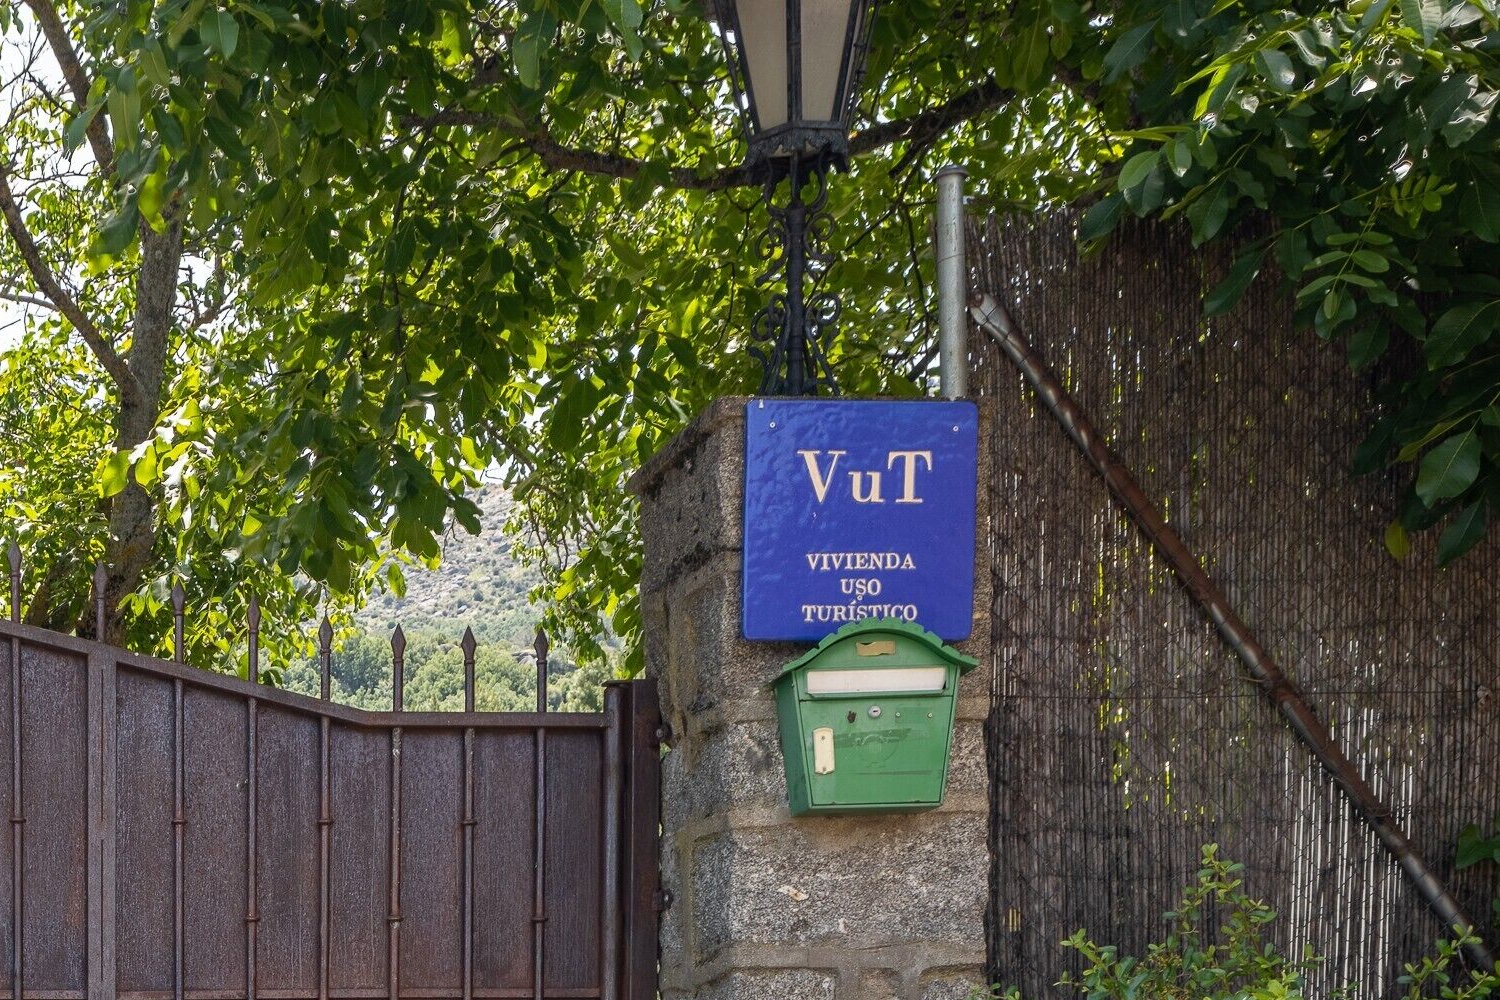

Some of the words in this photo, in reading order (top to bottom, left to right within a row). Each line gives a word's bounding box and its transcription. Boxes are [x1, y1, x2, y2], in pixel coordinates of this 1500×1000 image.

[797, 450, 933, 503] VuT
[806, 553, 915, 571] VIVIENDA
[841, 579, 881, 596] USO
[802, 600, 918, 622] TURÍSTICO
